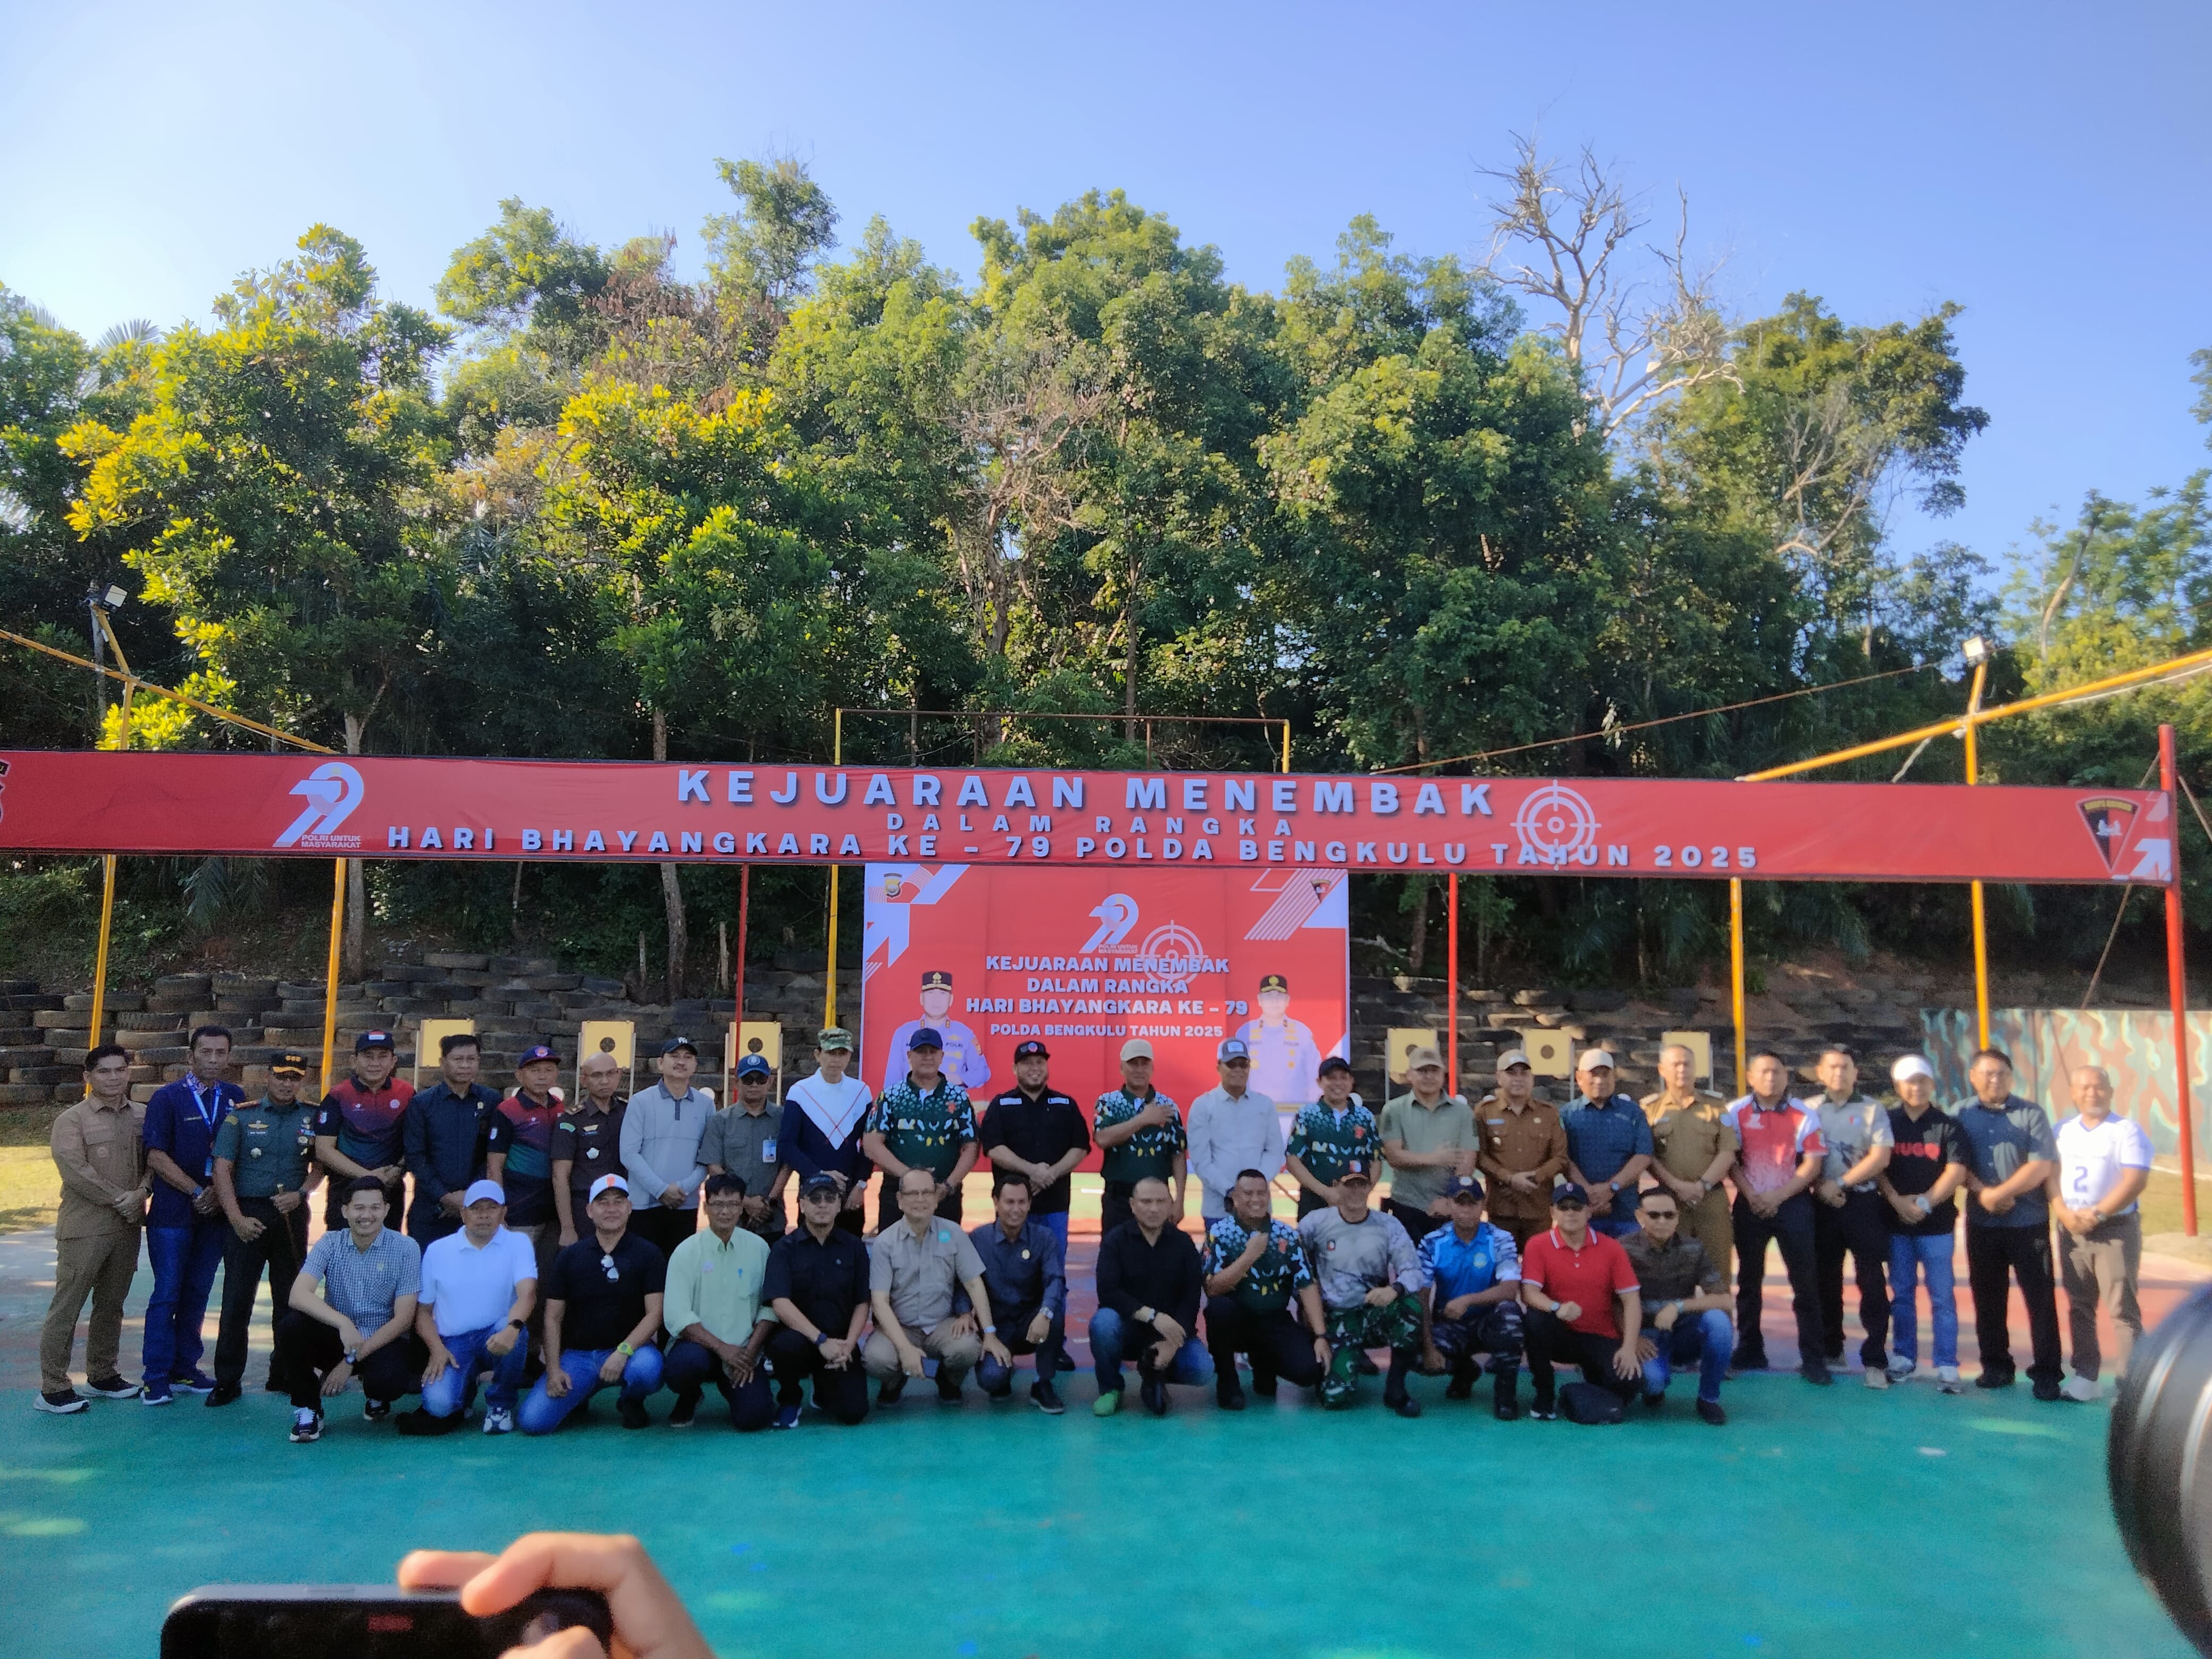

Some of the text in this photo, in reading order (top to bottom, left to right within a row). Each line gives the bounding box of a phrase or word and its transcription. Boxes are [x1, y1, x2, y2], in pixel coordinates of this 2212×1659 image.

[677, 769, 1493, 815] KEJUARAAN MENEMBAK
[887, 812, 1292, 836] DALAM RANGKA
[388, 826, 493, 849] HARI
[522, 828, 860, 855] BHAYANGKARA
[888, 834, 937, 857] KE
[1006, 836, 1050, 858] 79
[1077, 837, 1213, 860] POLDA
[1239, 839, 1466, 865] BENGKULU
[1490, 843, 1629, 867] TAHUN
[1653, 845, 1757, 868] 2025
[986, 956, 1229, 974] KEJUARAAN MENEMBAK
[1027, 977, 1189, 994] DALAM RANGKA
[966, 998, 1013, 1013] HARI
[1019, 998, 1172, 1015] BHAYANGKARA
[1178, 1001, 1204, 1015] KE
[1225, 1000, 1249, 1016] 79
[990, 1024, 1223, 1037] POLDA BENGKULU TAHUN 2025
[2073, 1166, 2088, 1192] 2
